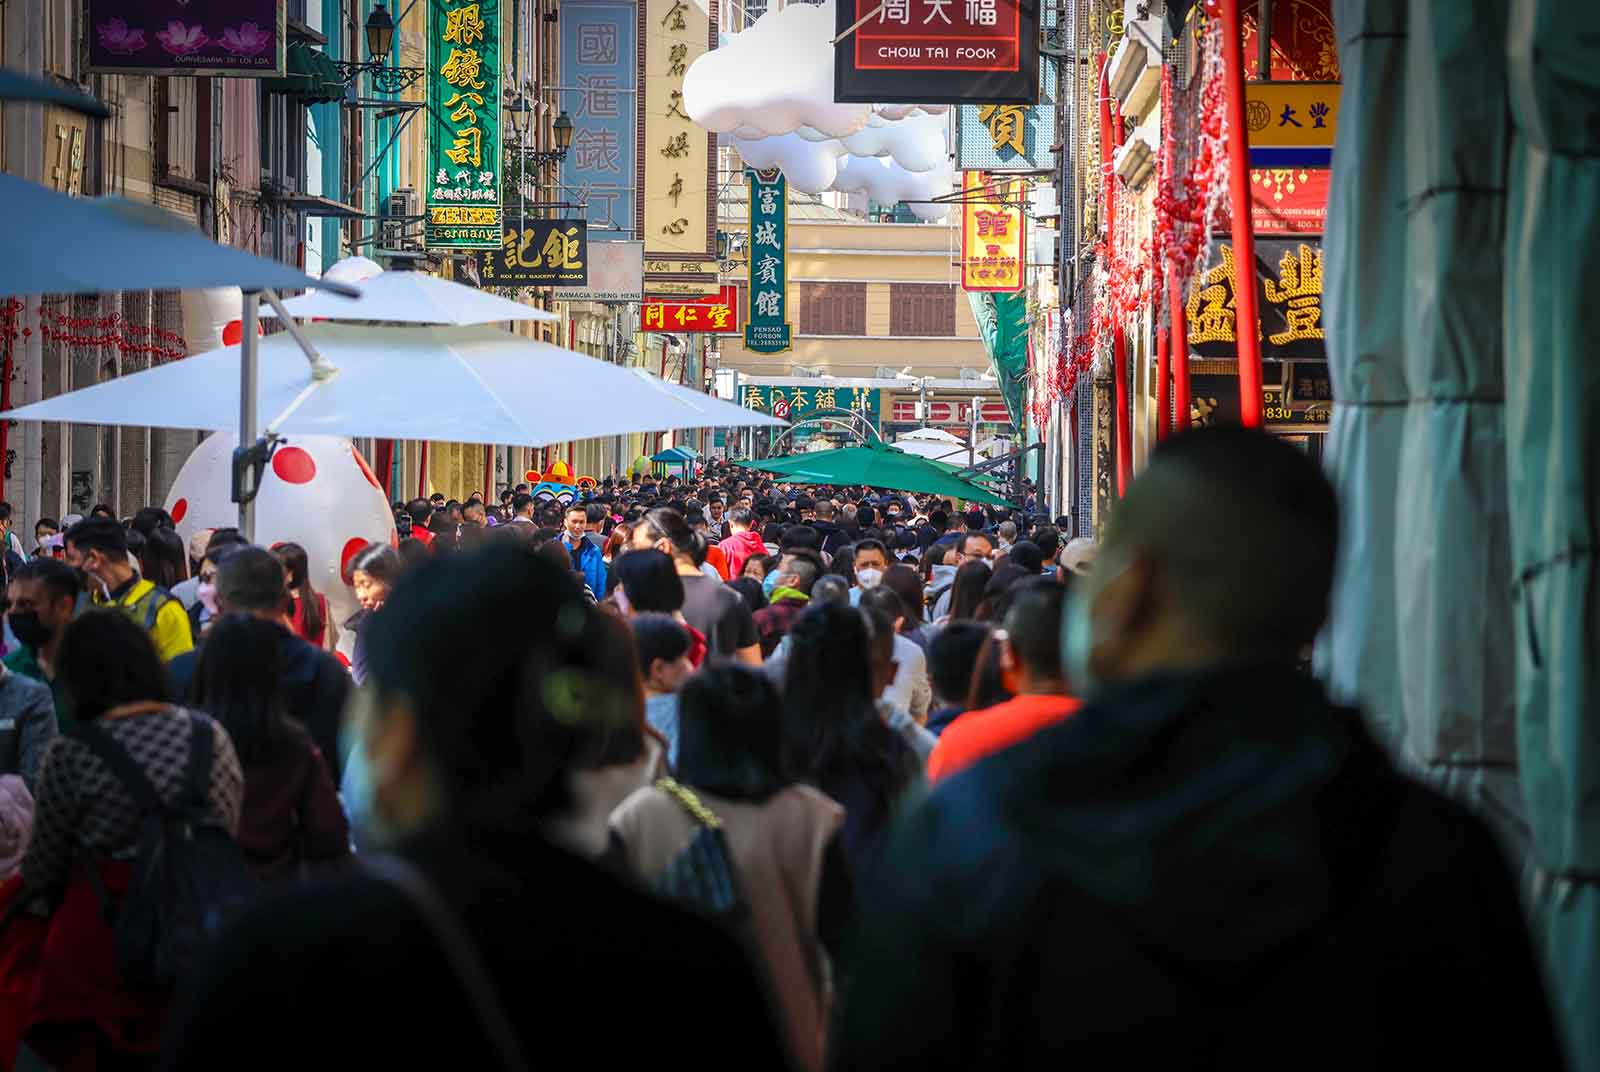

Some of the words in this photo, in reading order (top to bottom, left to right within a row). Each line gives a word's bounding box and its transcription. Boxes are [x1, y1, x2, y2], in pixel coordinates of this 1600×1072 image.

[879, 0, 998, 26] 周大福
[878, 47, 921, 58] CHOW
[926, 48, 949, 59] TAI
[955, 48, 996, 60] FOOK
[440, 3, 485, 168] 眼鏡公司
[431, 207, 497, 225] ZEISS
[433, 229, 496, 241] Germany
[755, 185, 782, 317] 富城賓館
[482, 251, 495, 279] 手信
[647, 262, 670, 272] KAM
[680, 262, 703, 272] PEK
[555, 291, 591, 299] FARMACIA
[594, 292, 618, 300] CHENG
[645, 304, 732, 329] 同仁堂
